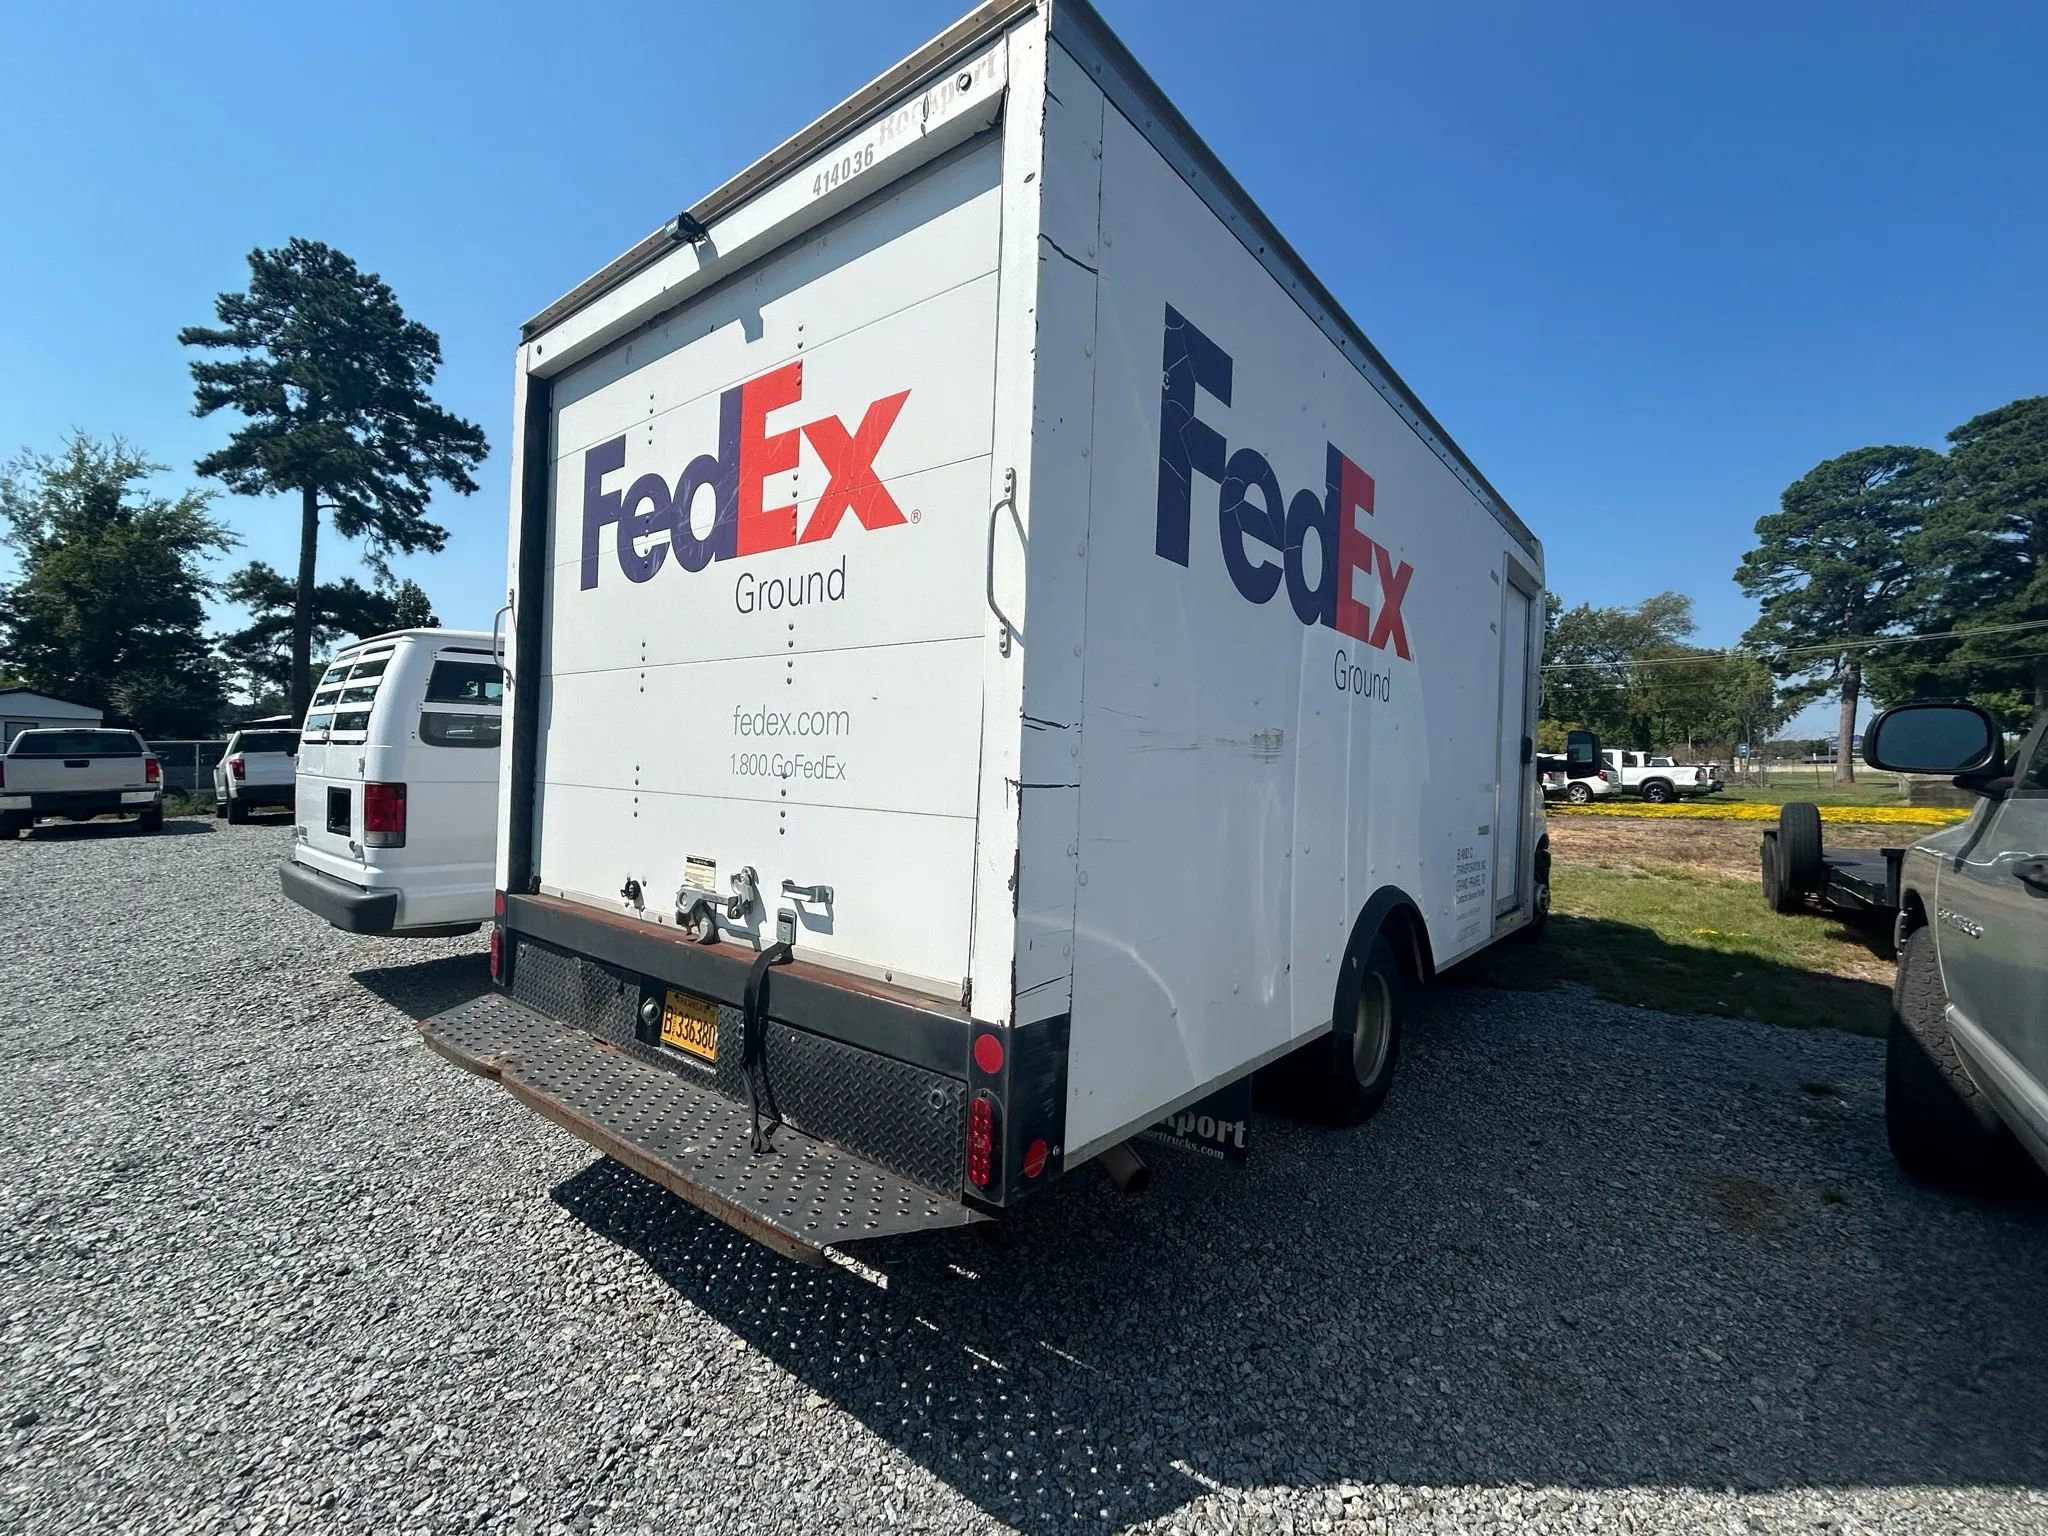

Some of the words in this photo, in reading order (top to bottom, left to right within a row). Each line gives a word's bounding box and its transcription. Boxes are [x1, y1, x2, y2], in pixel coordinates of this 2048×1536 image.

[813, 143, 874, 196] 414036
[580, 358, 912, 591] FedEx
[1155, 300, 1414, 662] FedEx
[735, 555, 846, 614] Ground
[1334, 649, 1391, 703] Ground
[733, 704, 850, 736] fedex.com
[730, 753, 847, 780] 1.800.GoFedEx
